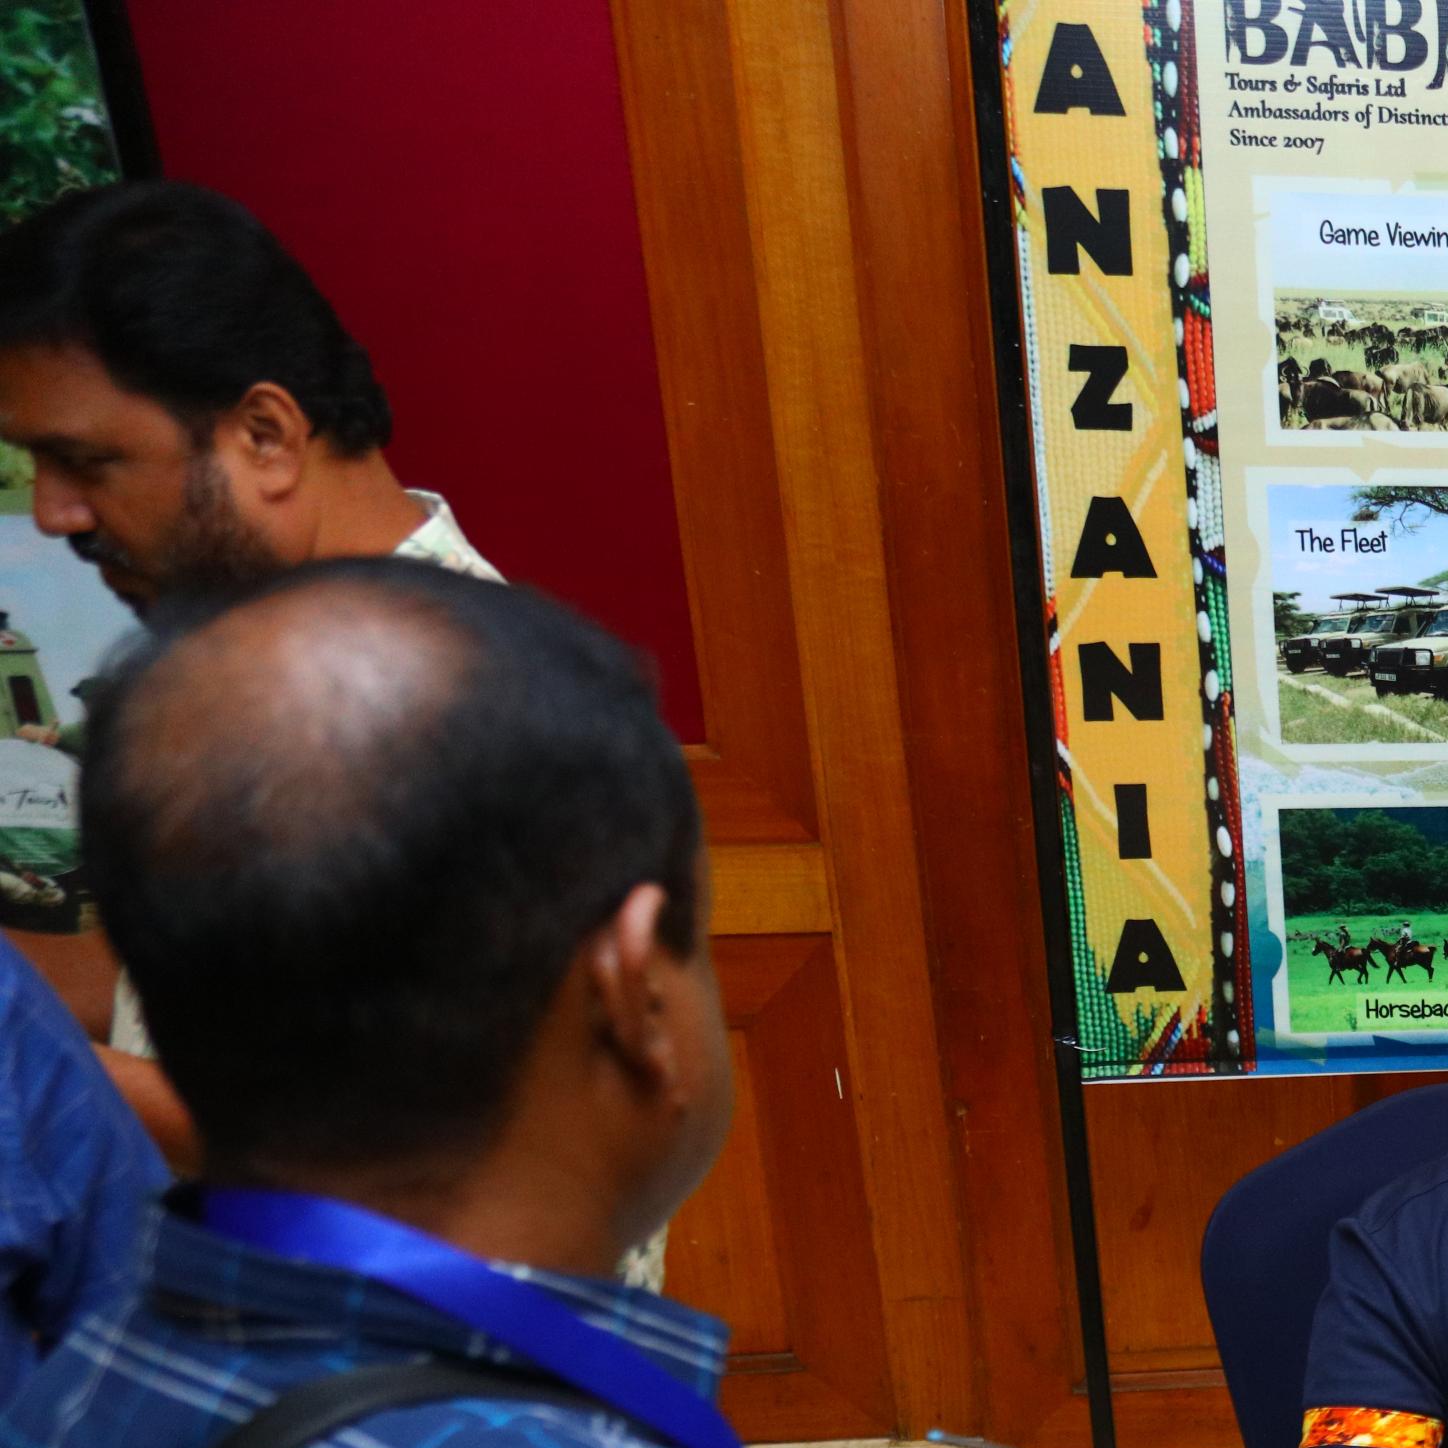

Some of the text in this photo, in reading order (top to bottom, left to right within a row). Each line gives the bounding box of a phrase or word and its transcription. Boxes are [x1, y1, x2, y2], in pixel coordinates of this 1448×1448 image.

[1225, 72, 1407, 100] Tours & Safaris Ltd
[1228, 100, 1349, 122] Ambassadors
[1355, 104, 1374, 129] of
[1230, 129, 1324, 155] Since 2007
[1319, 219, 1380, 247] Game
[1294, 528, 1388, 553] The Fleet
